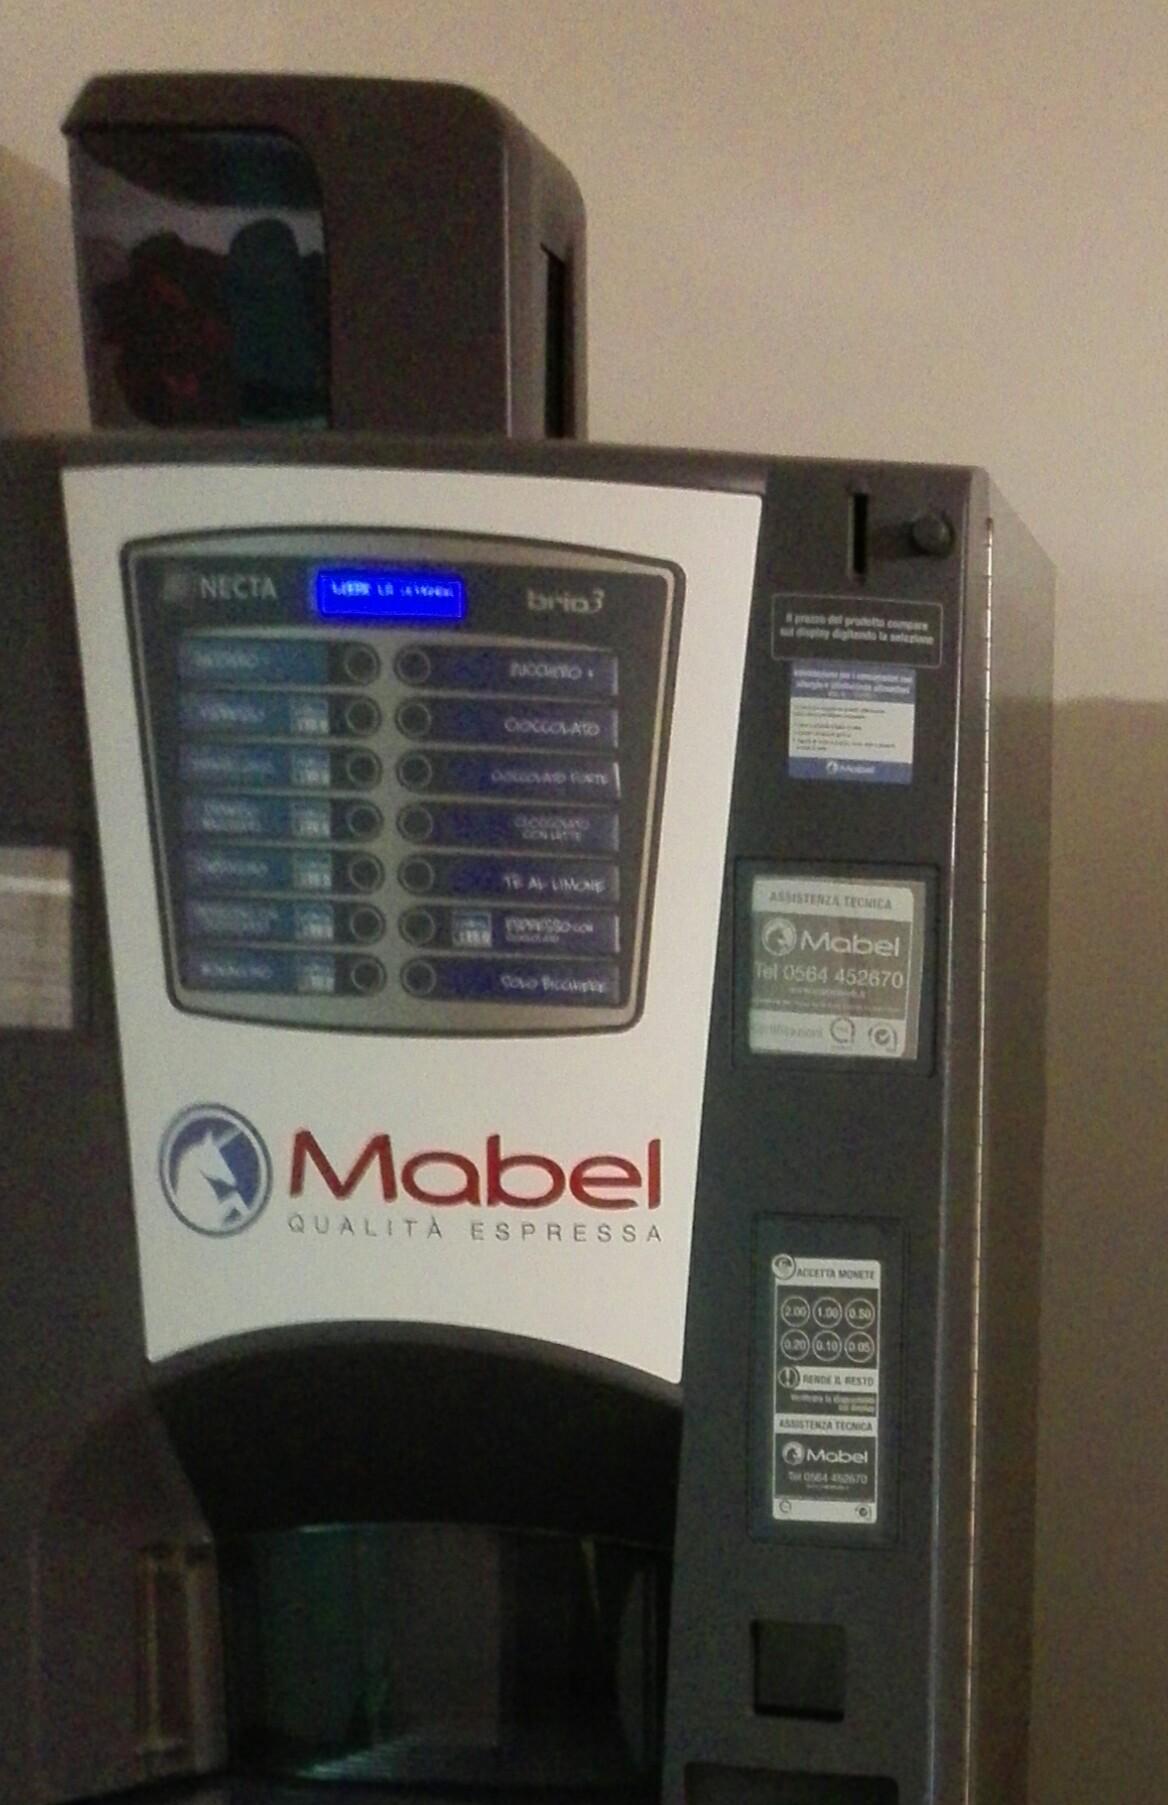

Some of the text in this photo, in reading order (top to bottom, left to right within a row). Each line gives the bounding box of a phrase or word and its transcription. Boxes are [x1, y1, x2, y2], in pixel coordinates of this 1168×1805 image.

[200, 577, 278, 599] NECTA
[769, 891, 893, 910] ASSISTENZA TECNICA
[801, 930, 900, 957] Mabel
[755, 961, 904, 989] Tel 0564 452670
[289, 1129, 662, 1211] Mabel
[288, 1214, 662, 1243] QUALITÀ ESPRESSA
[796, 1268, 875, 1281] ACCETTA MONETE
[784, 1306, 872, 1320] 2.00 1.00 0.50
[784, 1340, 807, 1351] 0.20
[815, 1340, 838, 1352] 0.10
[802, 1374, 831, 1385] RENDE
[845, 1376, 875, 1387] RESTO
[779, 1419, 873, 1432] ASSISTENZA TECNICA
[806, 1448, 869, 1464] Mabel
